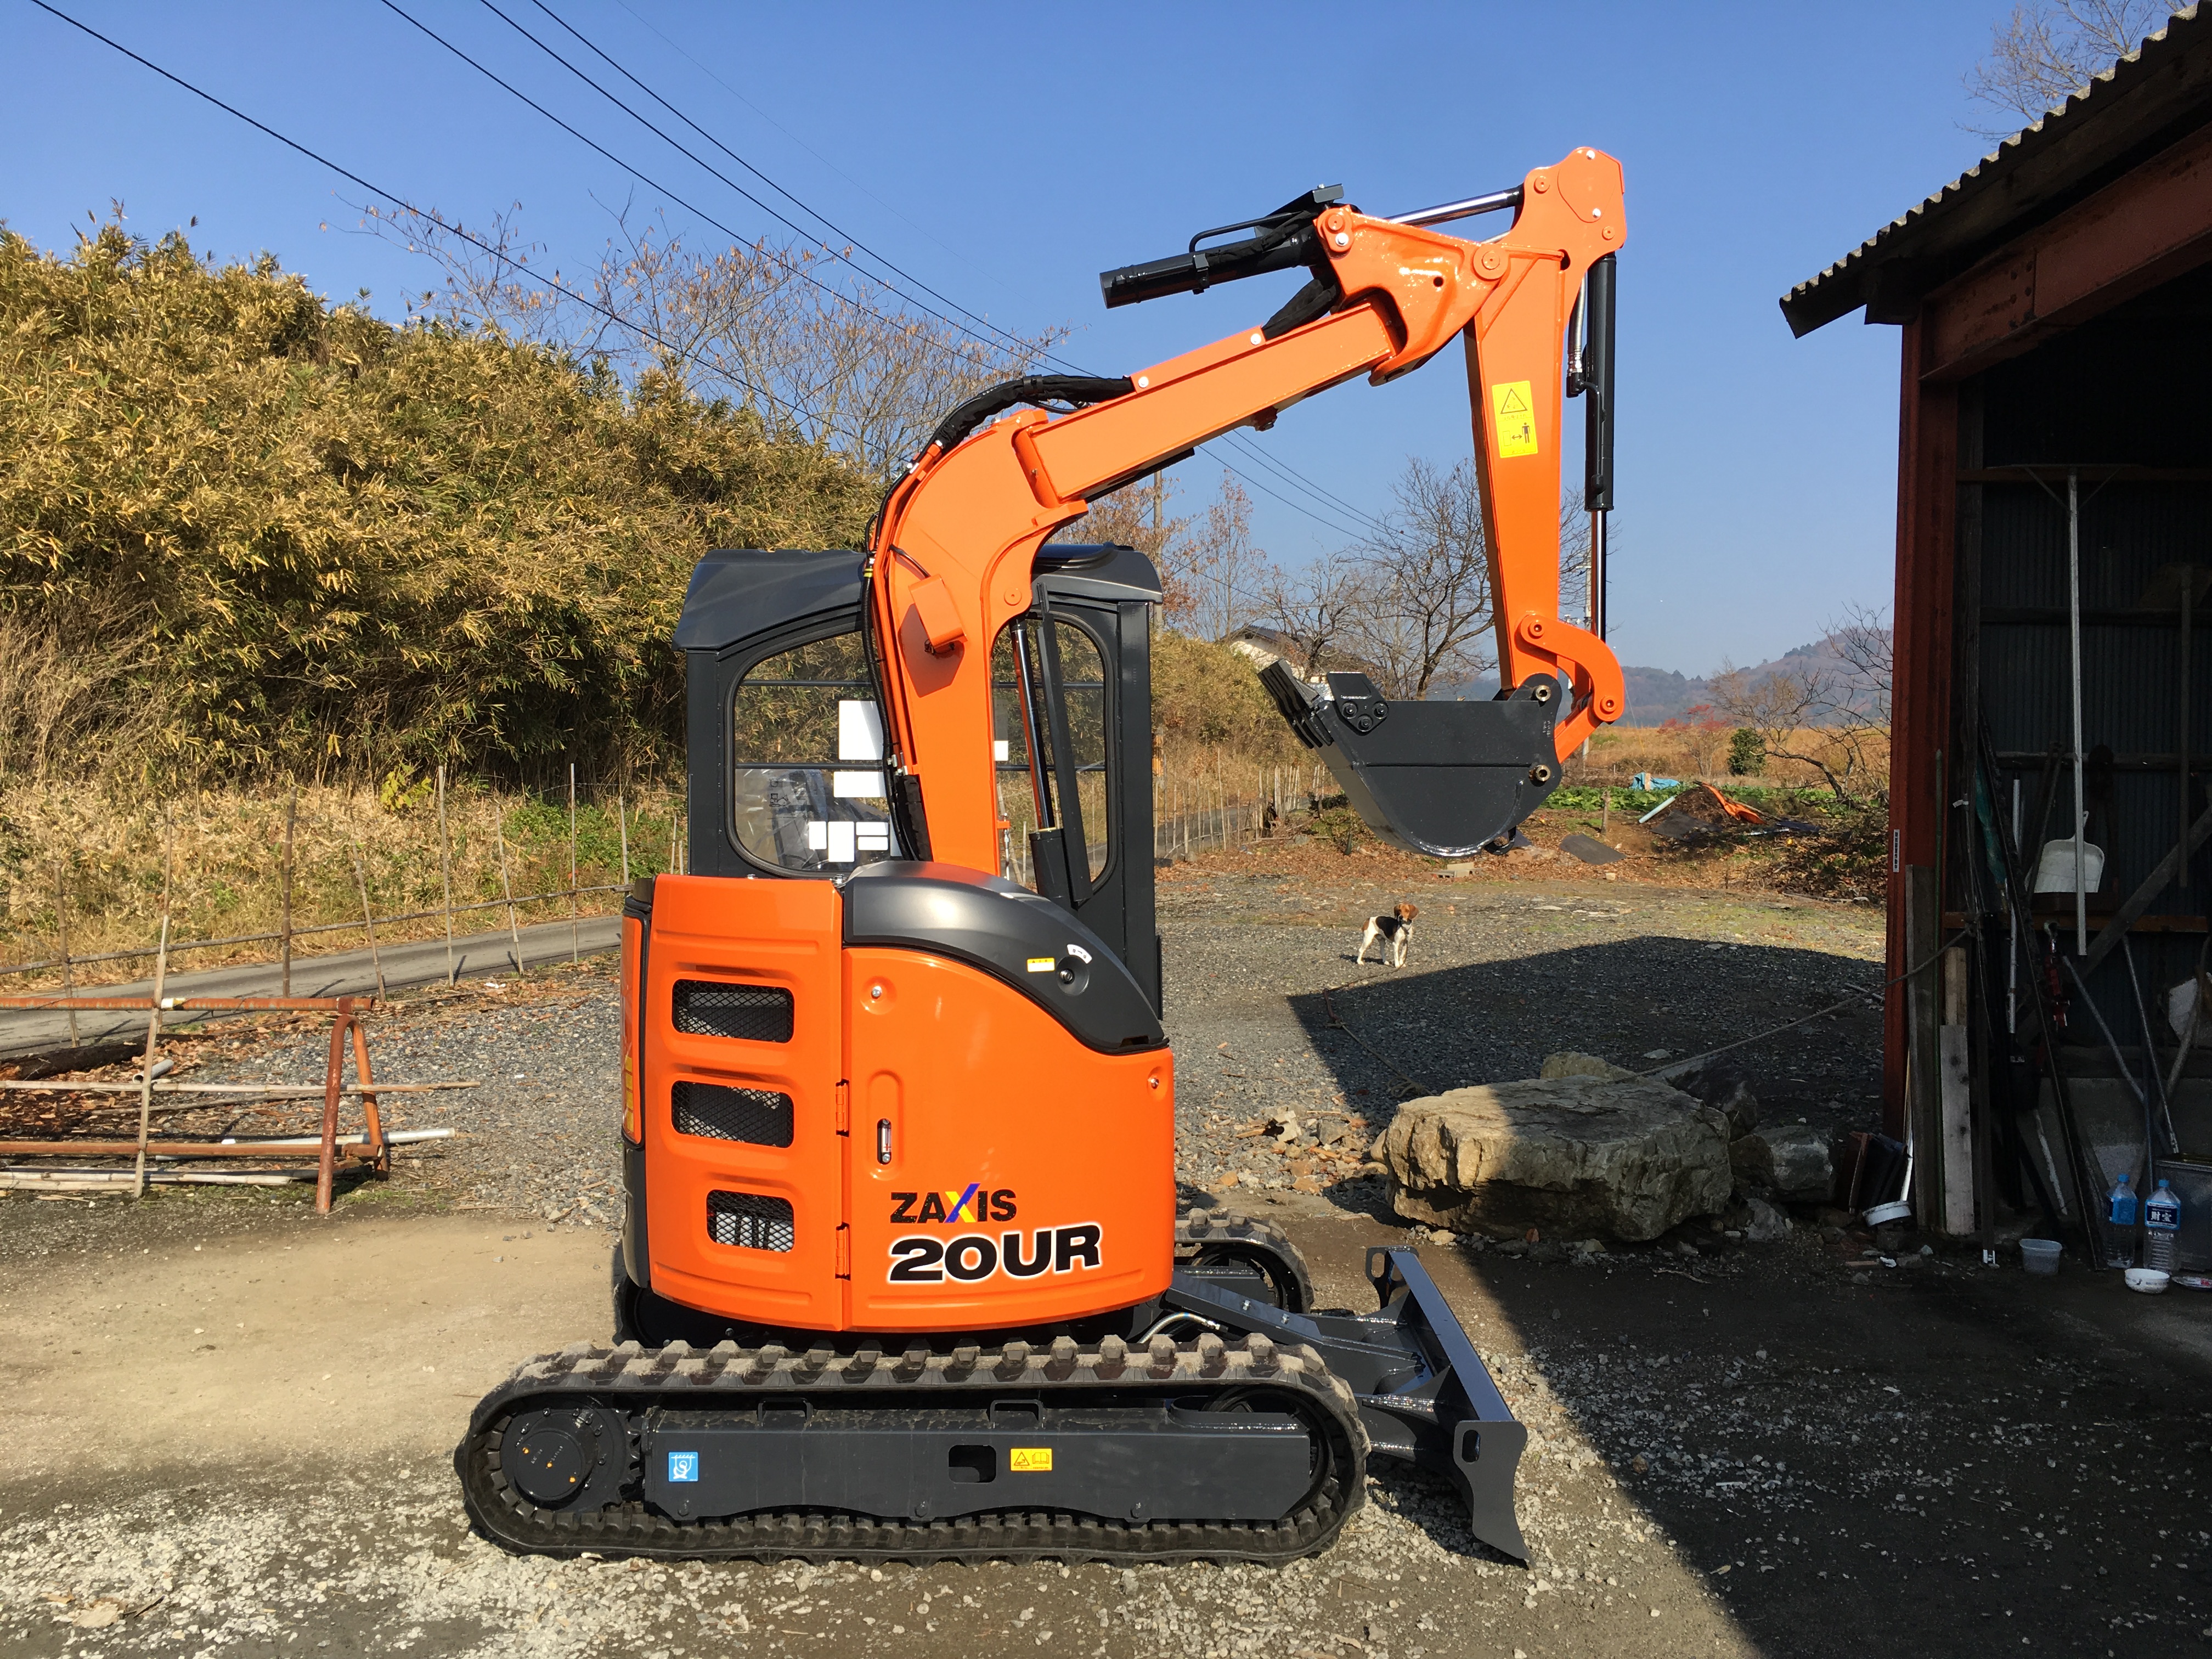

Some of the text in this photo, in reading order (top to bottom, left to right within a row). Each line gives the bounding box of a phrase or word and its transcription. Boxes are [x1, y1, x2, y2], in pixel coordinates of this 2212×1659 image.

[890, 1183, 1018, 1224] ZAXIS
[2151, 1211, 2172, 1222] 財宝
[888, 1224, 1102, 1283] 20UR
